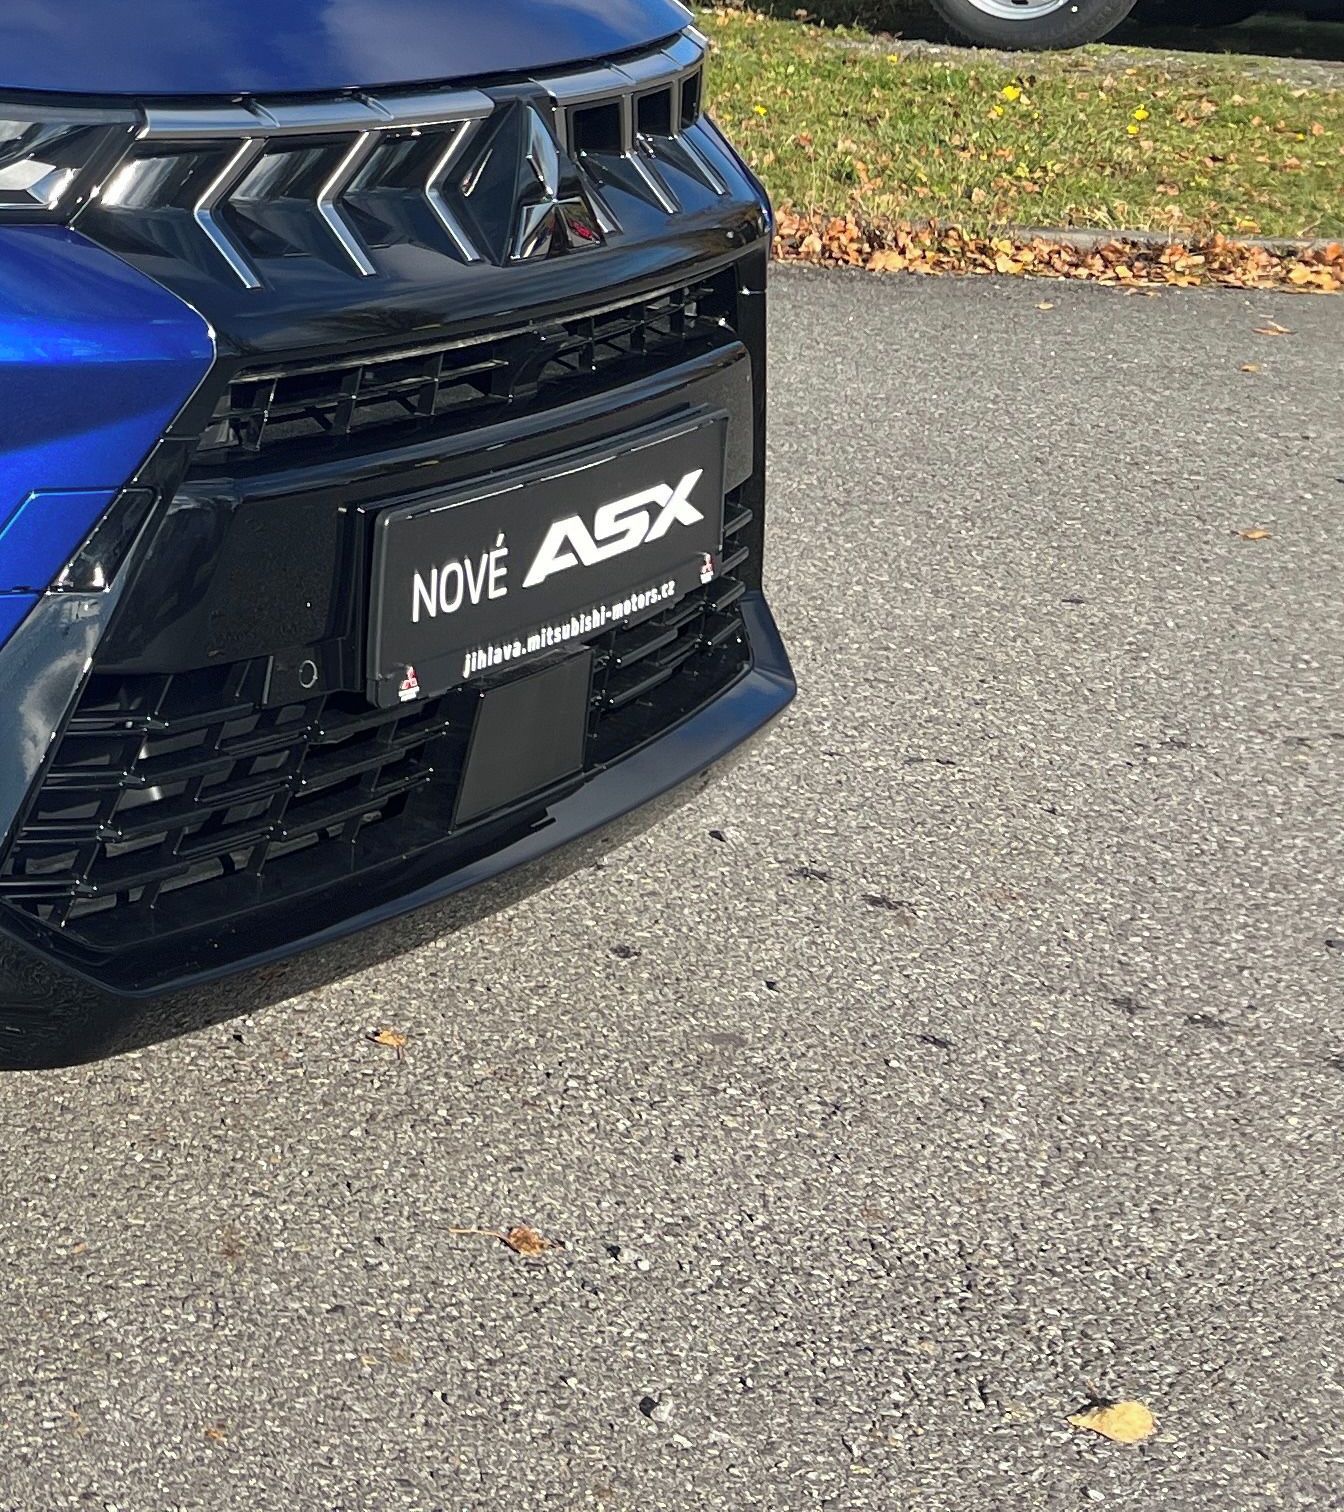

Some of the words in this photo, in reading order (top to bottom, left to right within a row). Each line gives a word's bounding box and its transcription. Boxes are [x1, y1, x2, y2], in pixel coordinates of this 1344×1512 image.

[411, 532, 509, 623] NOVÉ
[521, 468, 705, 589] ASX
[462, 579, 676, 679] jihlava.mitsubishi-motors.cz
